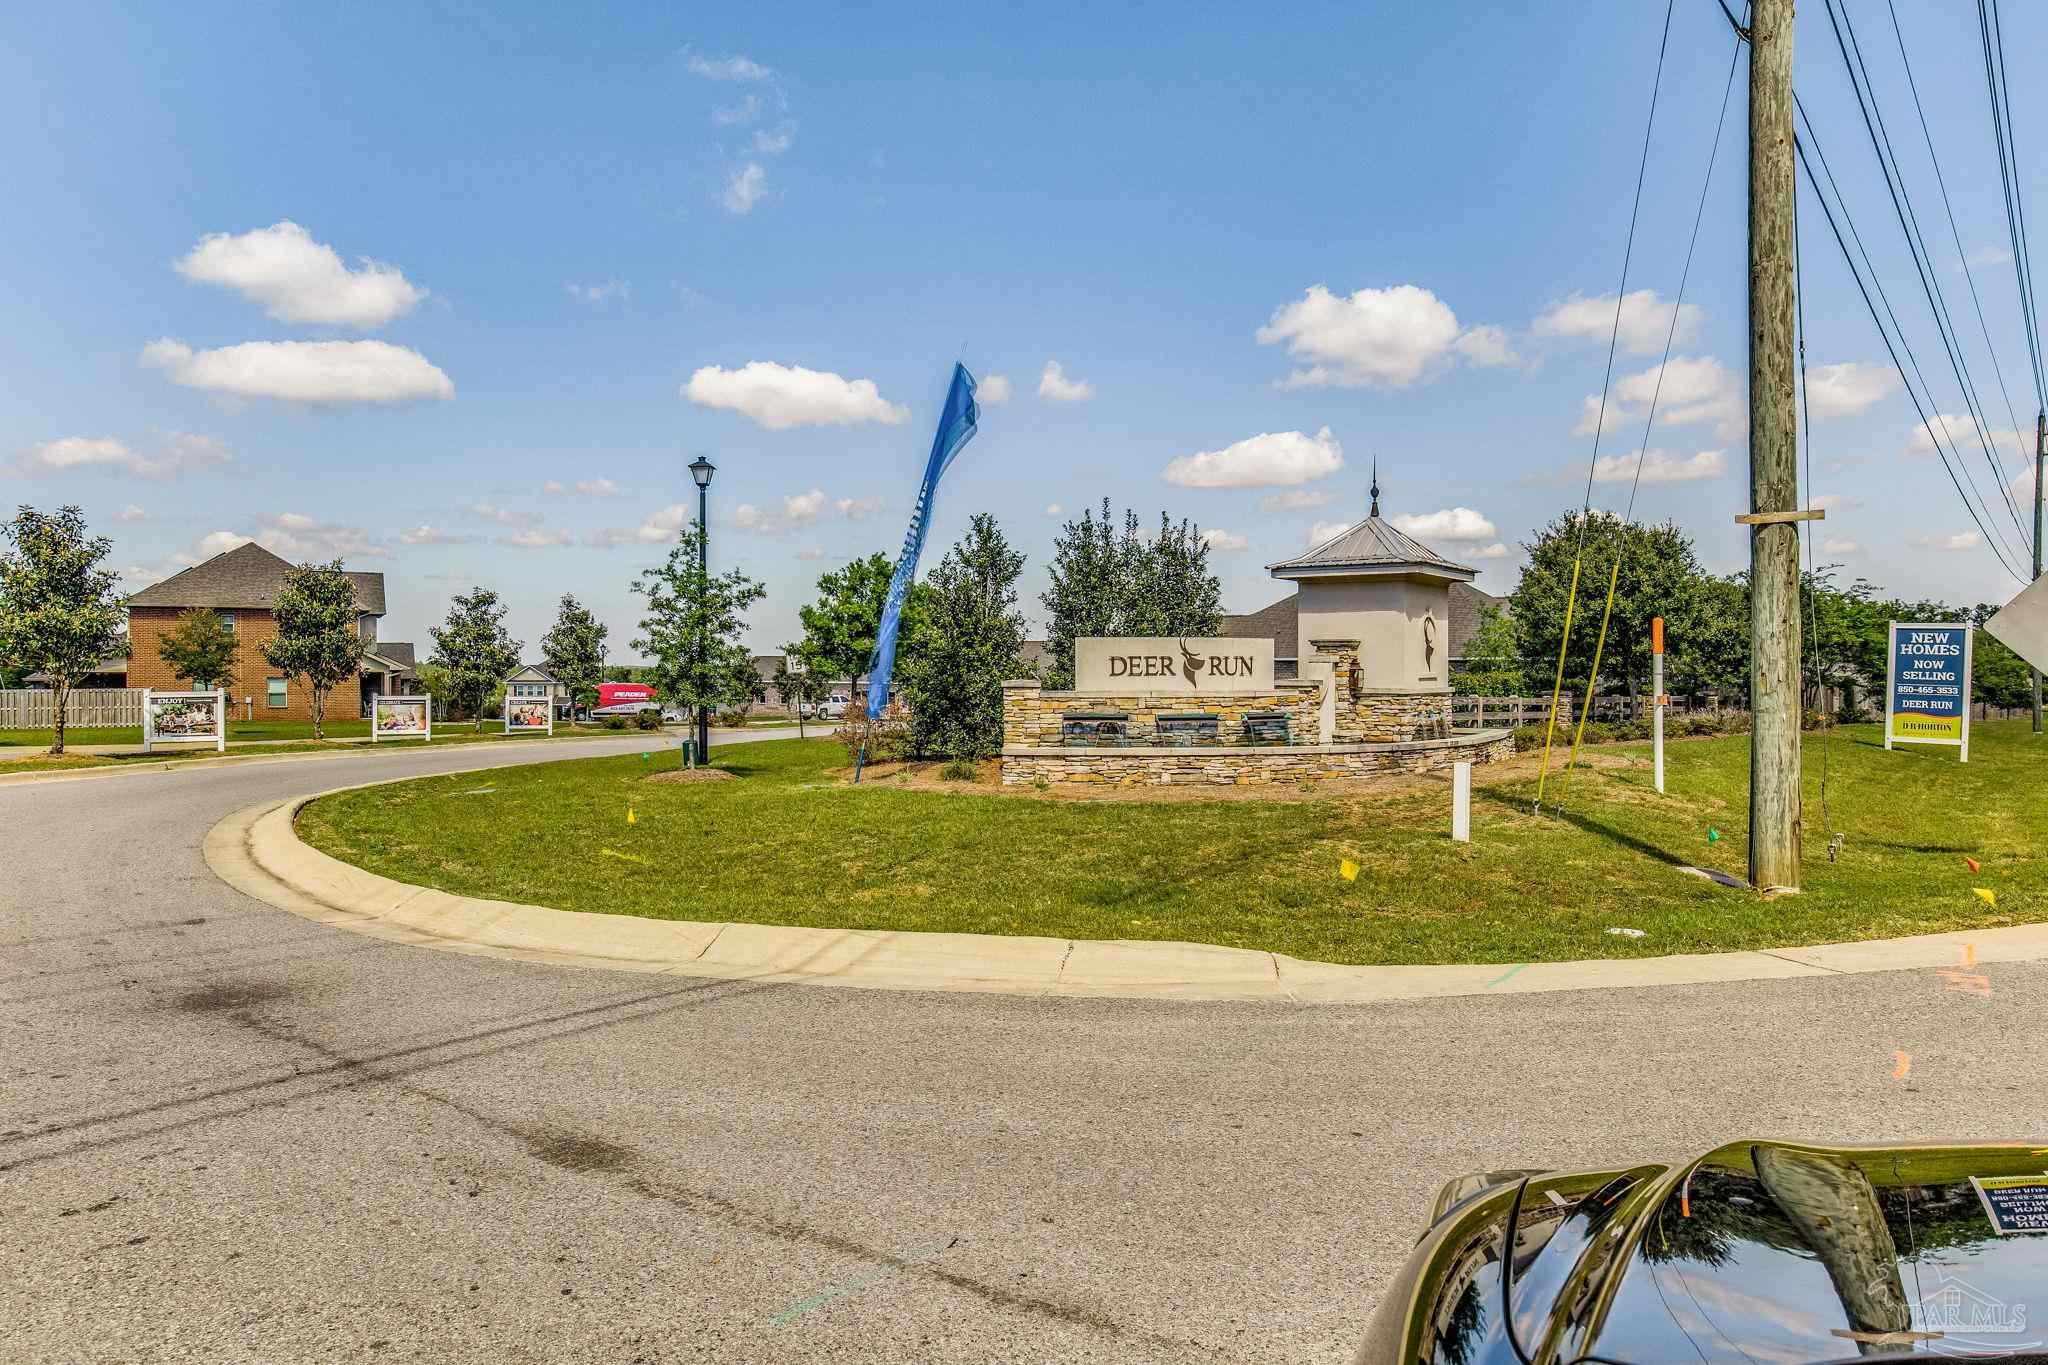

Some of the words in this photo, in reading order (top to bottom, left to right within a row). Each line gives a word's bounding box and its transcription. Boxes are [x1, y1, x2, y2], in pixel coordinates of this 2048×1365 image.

[1911, 632, 1950, 643] NEW
[1900, 644, 1960, 655] HOMES
[1109, 656, 1177, 677] DEER
[1208, 656, 1254, 676] RUN
[1913, 660, 1945, 669] NOW
[1902, 671, 1955, 681] SELLING
[1902, 699, 1929, 709] DEER
[1930, 700, 1953, 710] RUN
